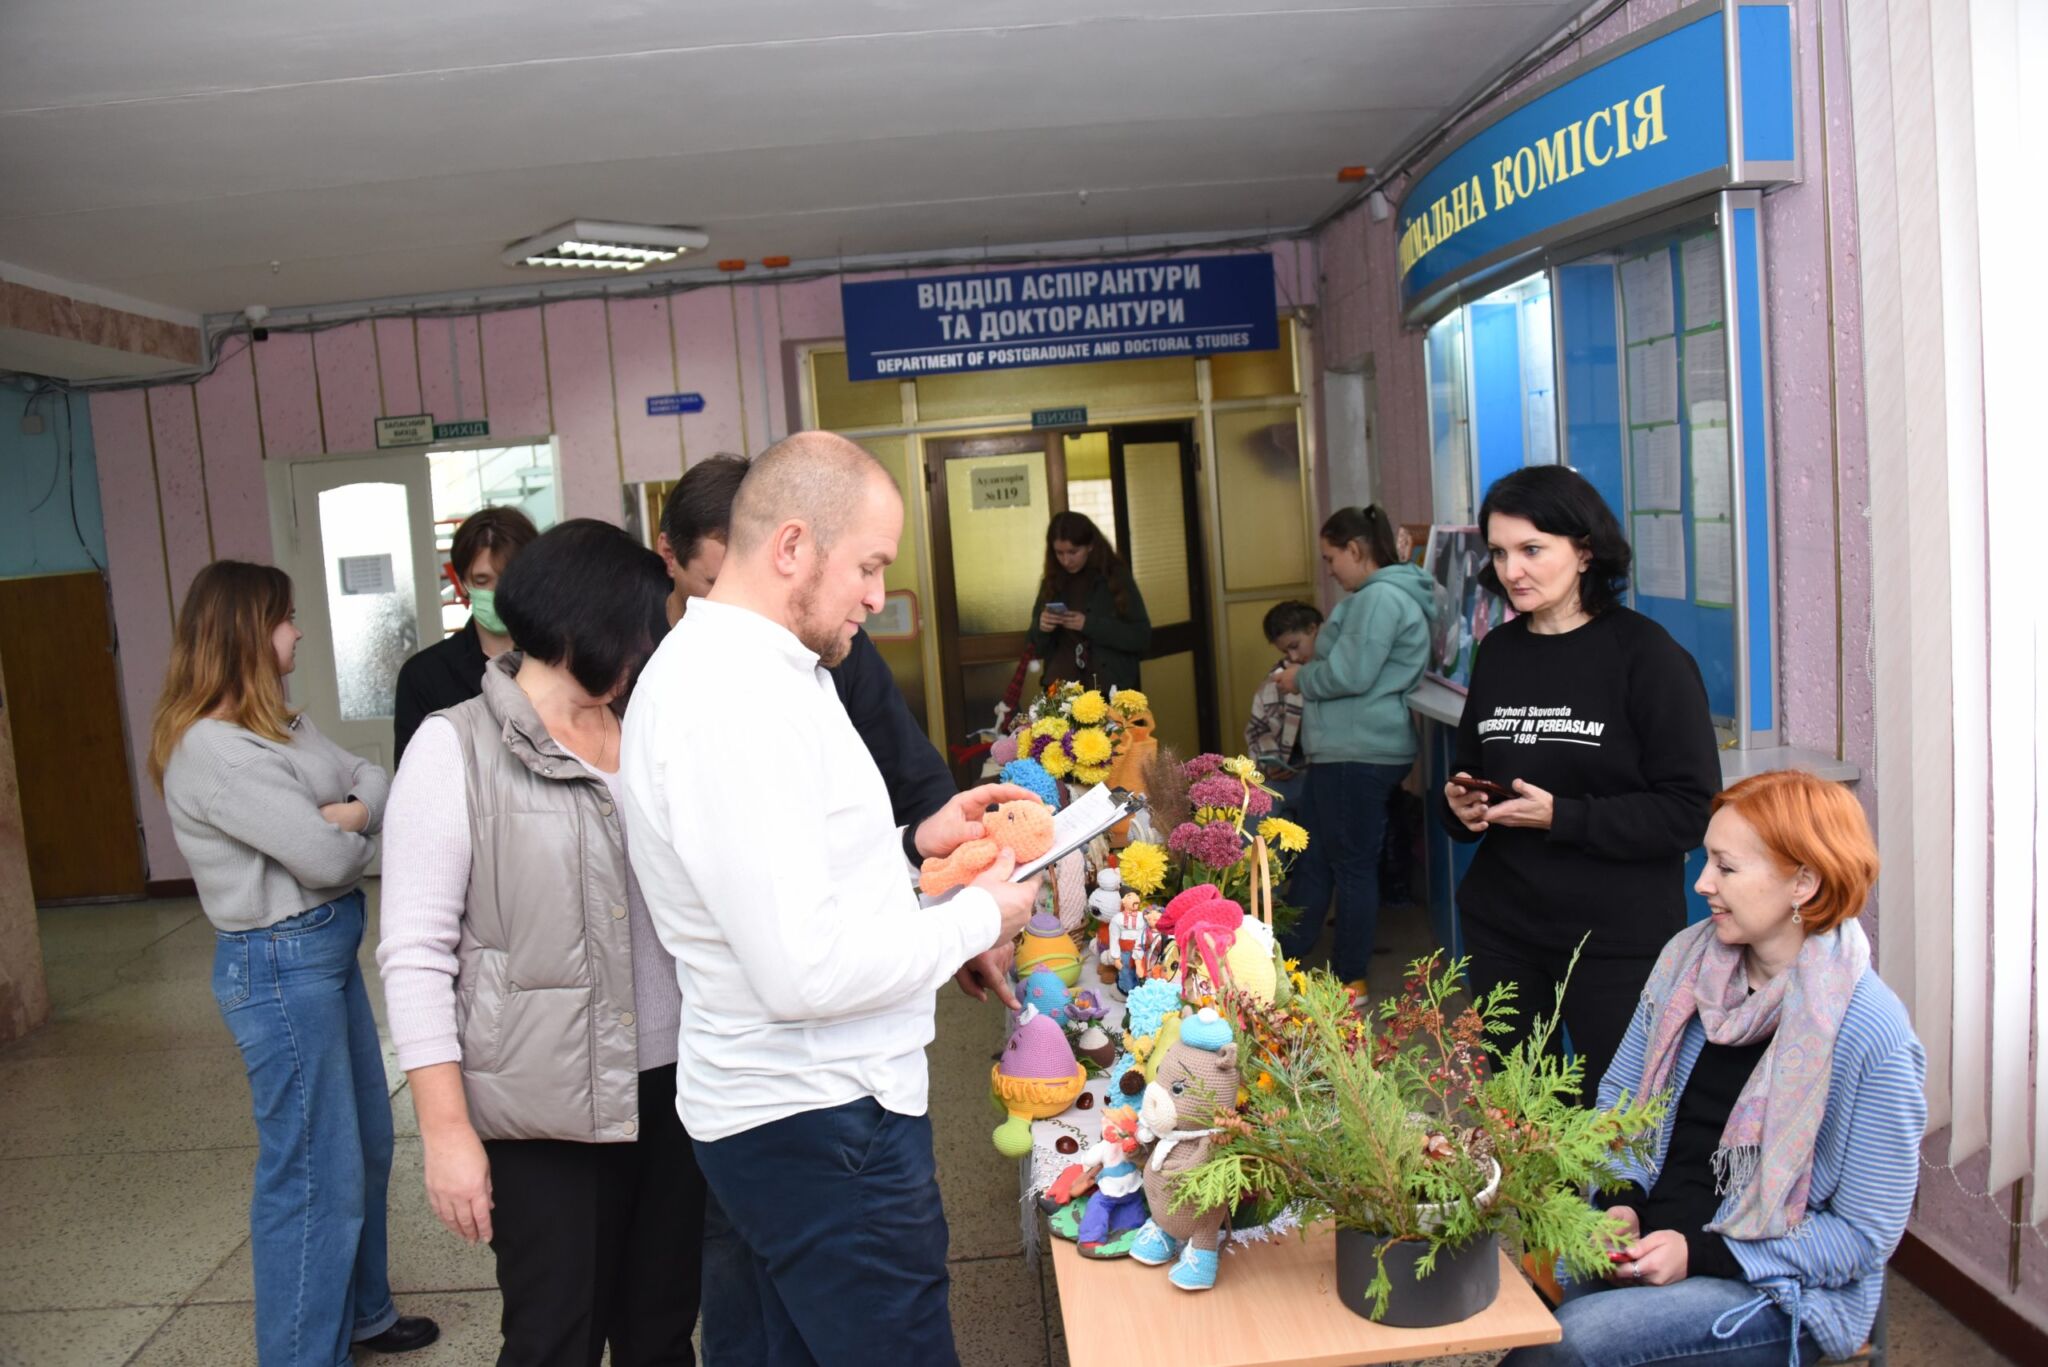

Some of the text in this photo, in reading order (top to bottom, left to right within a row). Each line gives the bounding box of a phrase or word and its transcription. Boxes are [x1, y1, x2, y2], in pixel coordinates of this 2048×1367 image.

[1492, 84, 1668, 211] КОМІСІЯ
[917, 263, 1202, 311] ВІДДІЛ АСПІРАНТУРИ
[938, 298, 1185, 342] ТА ДОКТОРАНТУРИ
[876, 332, 1250, 374] DEPARTMENT OF POSTGRADUATE AND DOCTORAL STUDIES
[1036, 410, 1083, 425] ВИХІД
[438, 422, 484, 437] ВИХІД
[1493, 706, 1572, 718] Hryhorii Skovoroda
[1521, 719, 1535, 732] IN
[1535, 718, 1604, 737] PEREIASLAV
[1513, 733, 1538, 744] 1986
